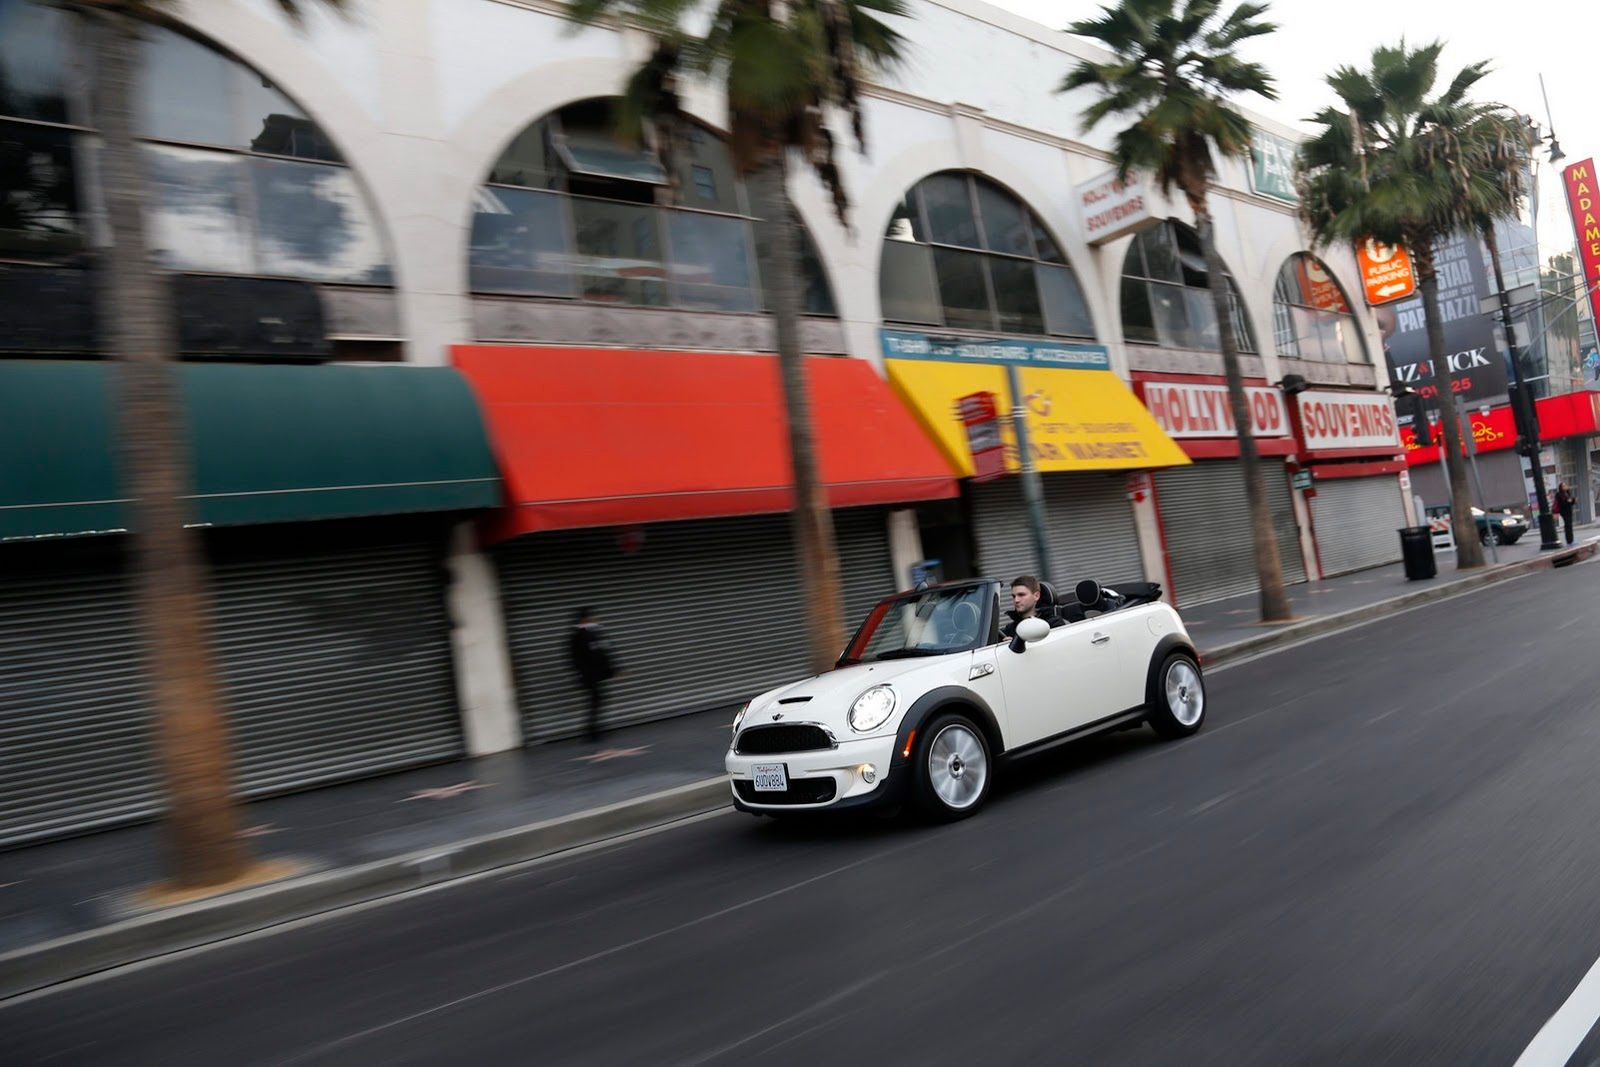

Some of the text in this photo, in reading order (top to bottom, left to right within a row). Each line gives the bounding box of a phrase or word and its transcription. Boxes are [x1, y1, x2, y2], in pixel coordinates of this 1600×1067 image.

[1366, 268, 1409, 287] PARKING
[1368, 259, 1403, 276] PUBLIC
[1397, 294, 1480, 333] PAPRAZZI
[1451, 377, 1472, 392] 25
[1146, 387, 1280, 433] HOLLYWOD
[1302, 400, 1394, 439] SOUVENIRS
